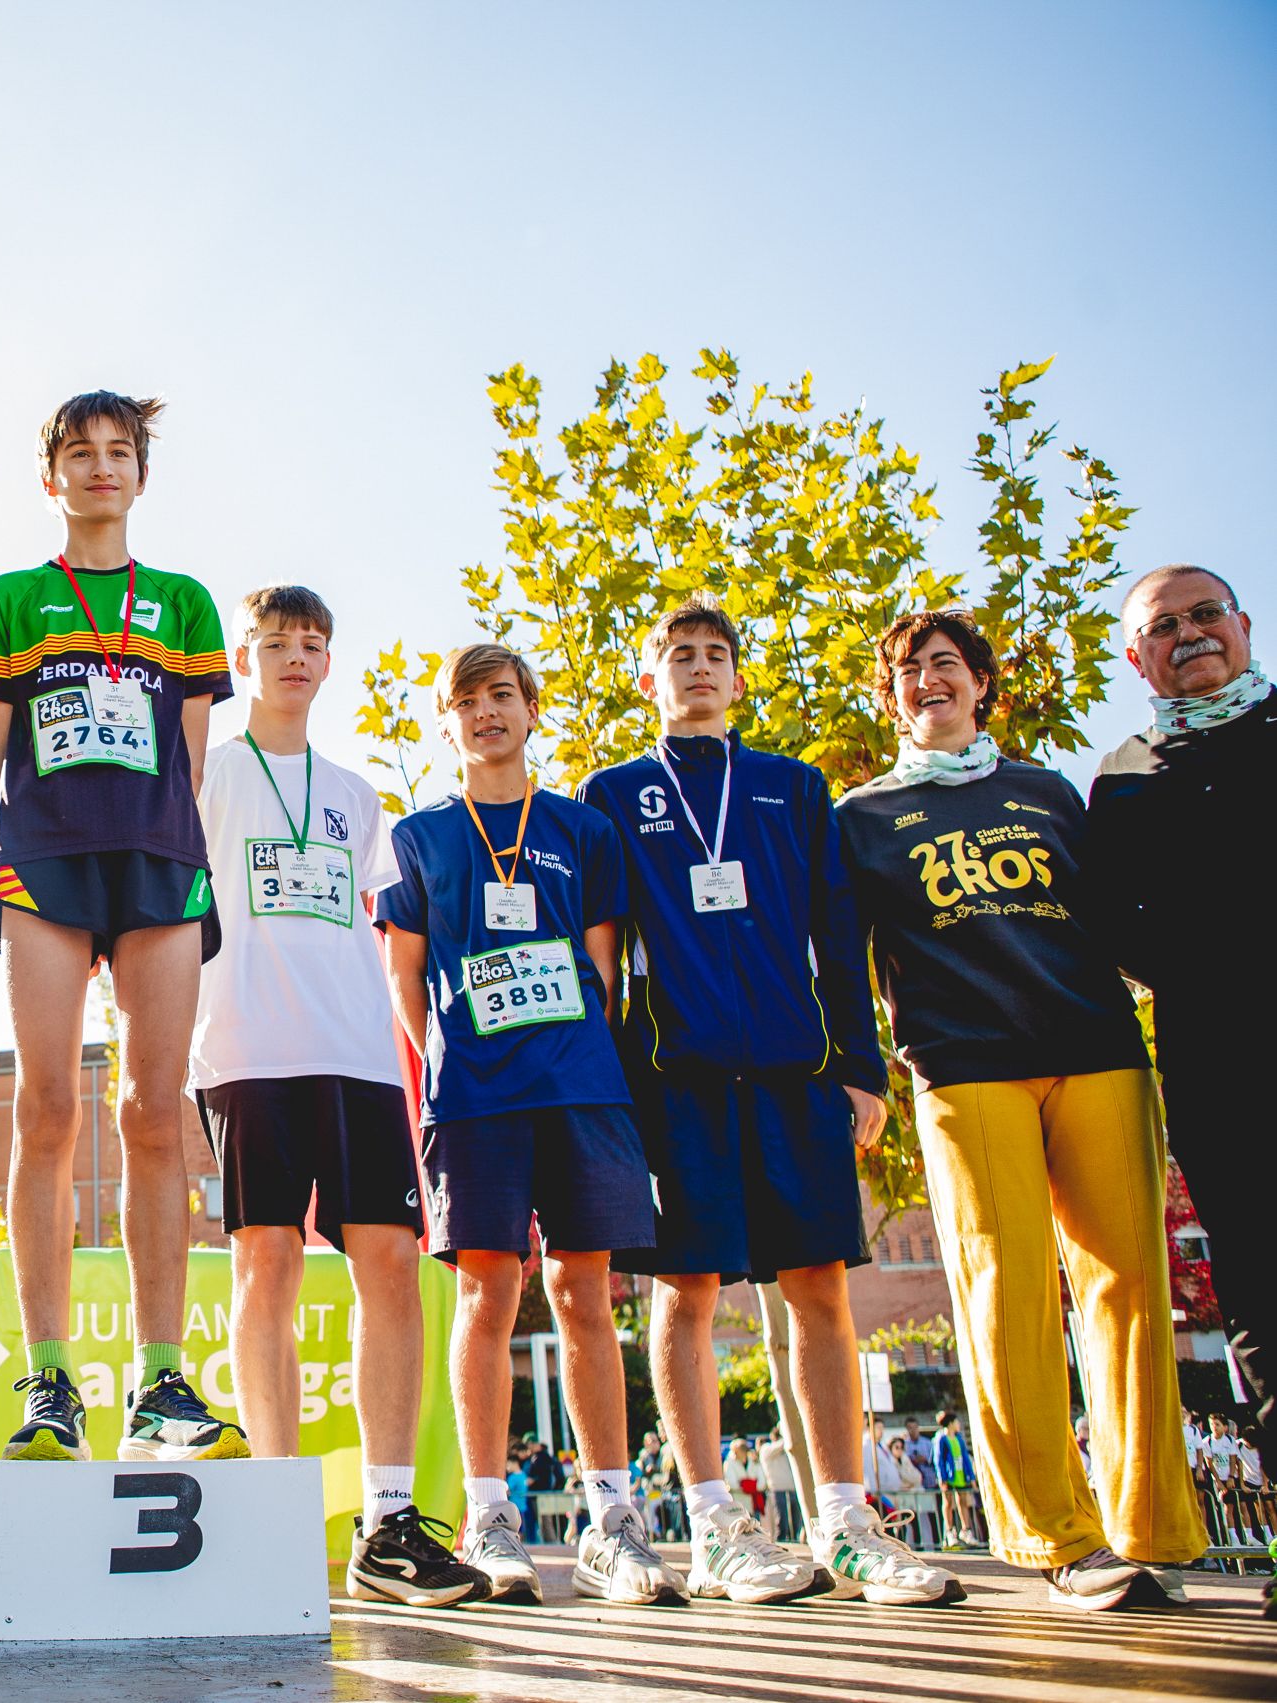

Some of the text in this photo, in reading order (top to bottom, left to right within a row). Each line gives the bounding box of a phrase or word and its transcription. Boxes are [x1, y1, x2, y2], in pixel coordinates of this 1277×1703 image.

[40, 702, 85, 722] CROS
[51, 726, 139, 752] 2764
[753, 796, 784, 804] HEAD
[895, 811, 924, 825] OMET
[639, 821, 673, 834] SET ONE
[975, 824, 1027, 839] Ciutat de
[979, 831, 1041, 846] Sant Cugat
[255, 853, 277, 866] CR
[542, 852, 560, 862] LICEU
[926, 848, 1053, 907] CROS
[263, 878, 340, 905] 34
[472, 963, 513, 984] CROS
[487, 982, 563, 1012] 3891
[109, 1472, 203, 1574] 3
